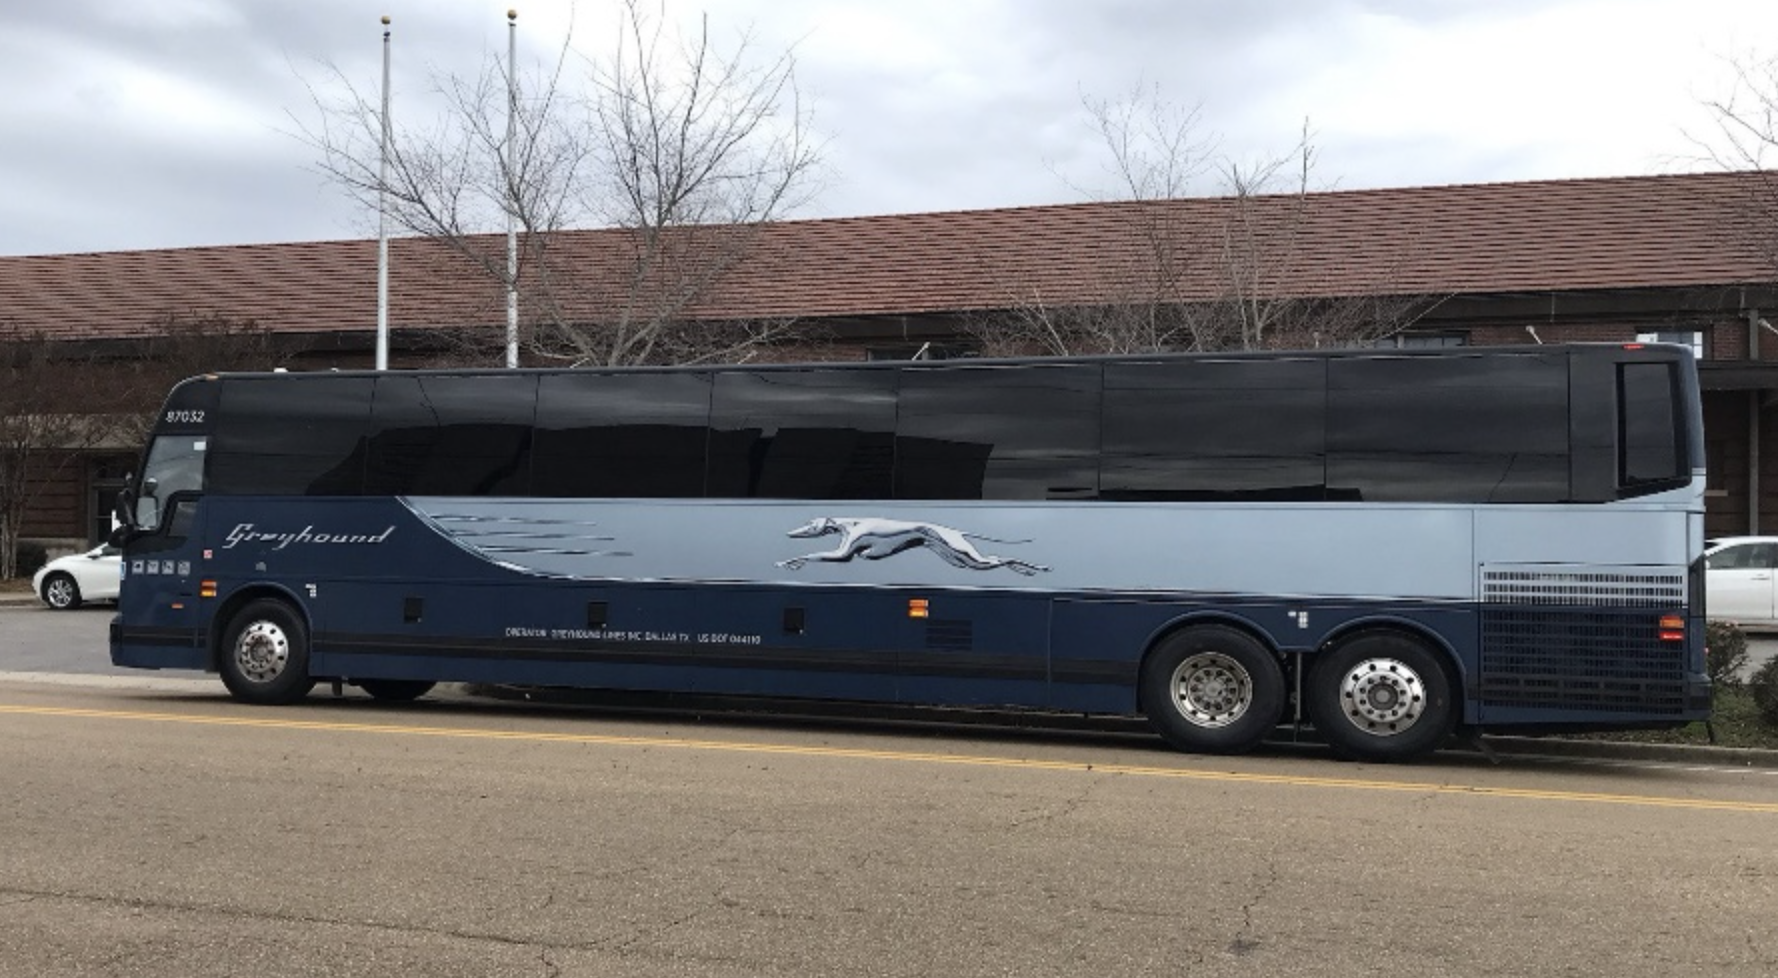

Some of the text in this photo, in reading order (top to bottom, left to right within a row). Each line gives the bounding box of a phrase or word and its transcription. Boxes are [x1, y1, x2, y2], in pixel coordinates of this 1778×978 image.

[165, 410, 205, 423] 87032
[222, 523, 396, 550] Greyhound
[697, 633, 709, 643] US
[711, 633, 728, 643] DOT
